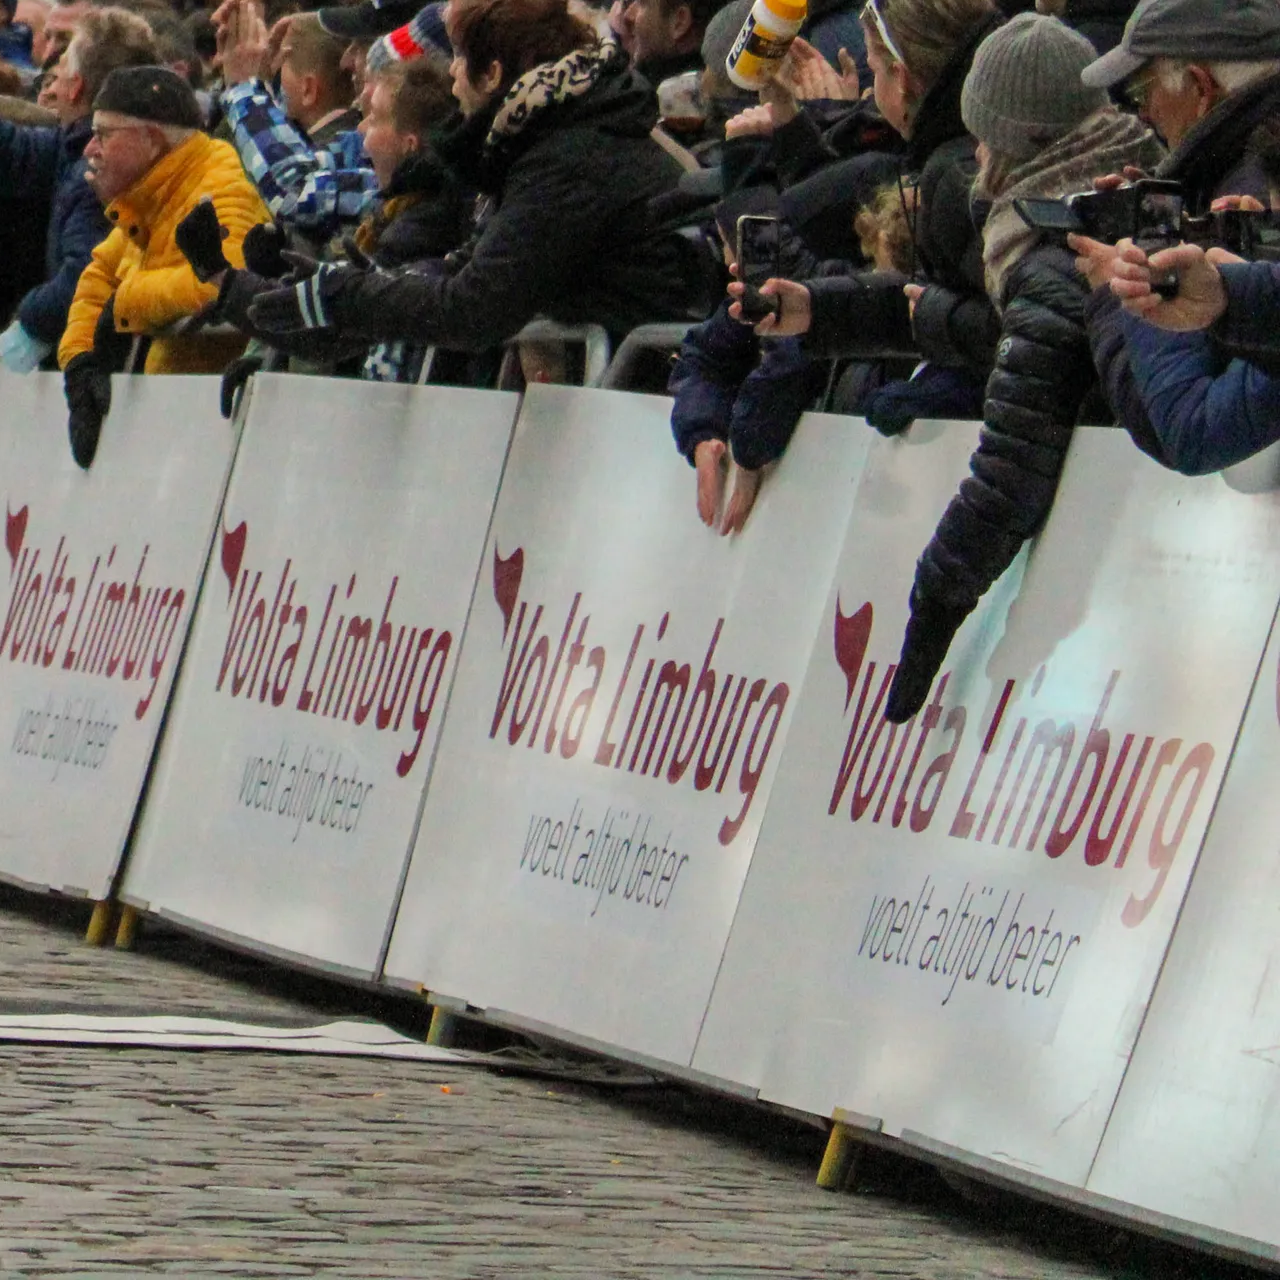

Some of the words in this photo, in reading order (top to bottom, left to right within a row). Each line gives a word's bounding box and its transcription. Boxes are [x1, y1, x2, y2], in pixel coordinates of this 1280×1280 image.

[62, 544, 185, 721] Limburg
[216, 559, 308, 707] Volta
[296, 572, 452, 778] Limburg
[489, 592, 605, 759] Volta
[593, 611, 790, 846] Limburg
[240, 739, 288, 812] voelt
[319, 751, 373, 833] beter
[520, 798, 583, 881] voelt
[572, 807, 642, 917] altijd
[624, 813, 689, 910] beter
[948, 663, 1216, 929] Limburg
[857, 874, 935, 966] voelt
[918, 882, 1009, 1006] altijd
[987, 892, 1081, 998] beter
